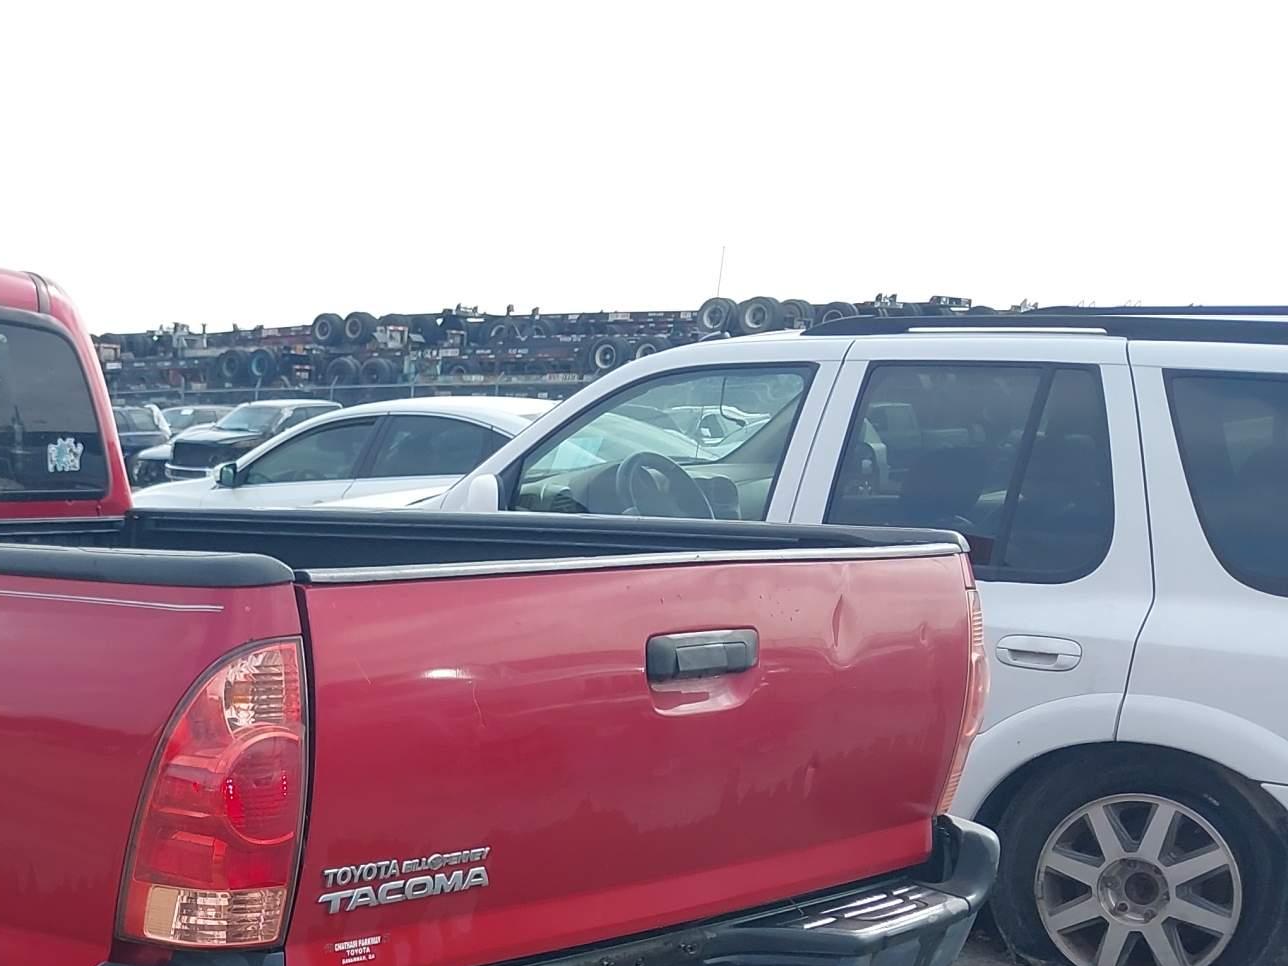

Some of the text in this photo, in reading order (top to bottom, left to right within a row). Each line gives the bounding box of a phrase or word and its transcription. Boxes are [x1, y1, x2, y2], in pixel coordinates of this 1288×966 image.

[324, 860, 400, 887] TOYOTA
[318, 866, 489, 914] TACOMA
[347, 947, 371, 956] TOYOTA
